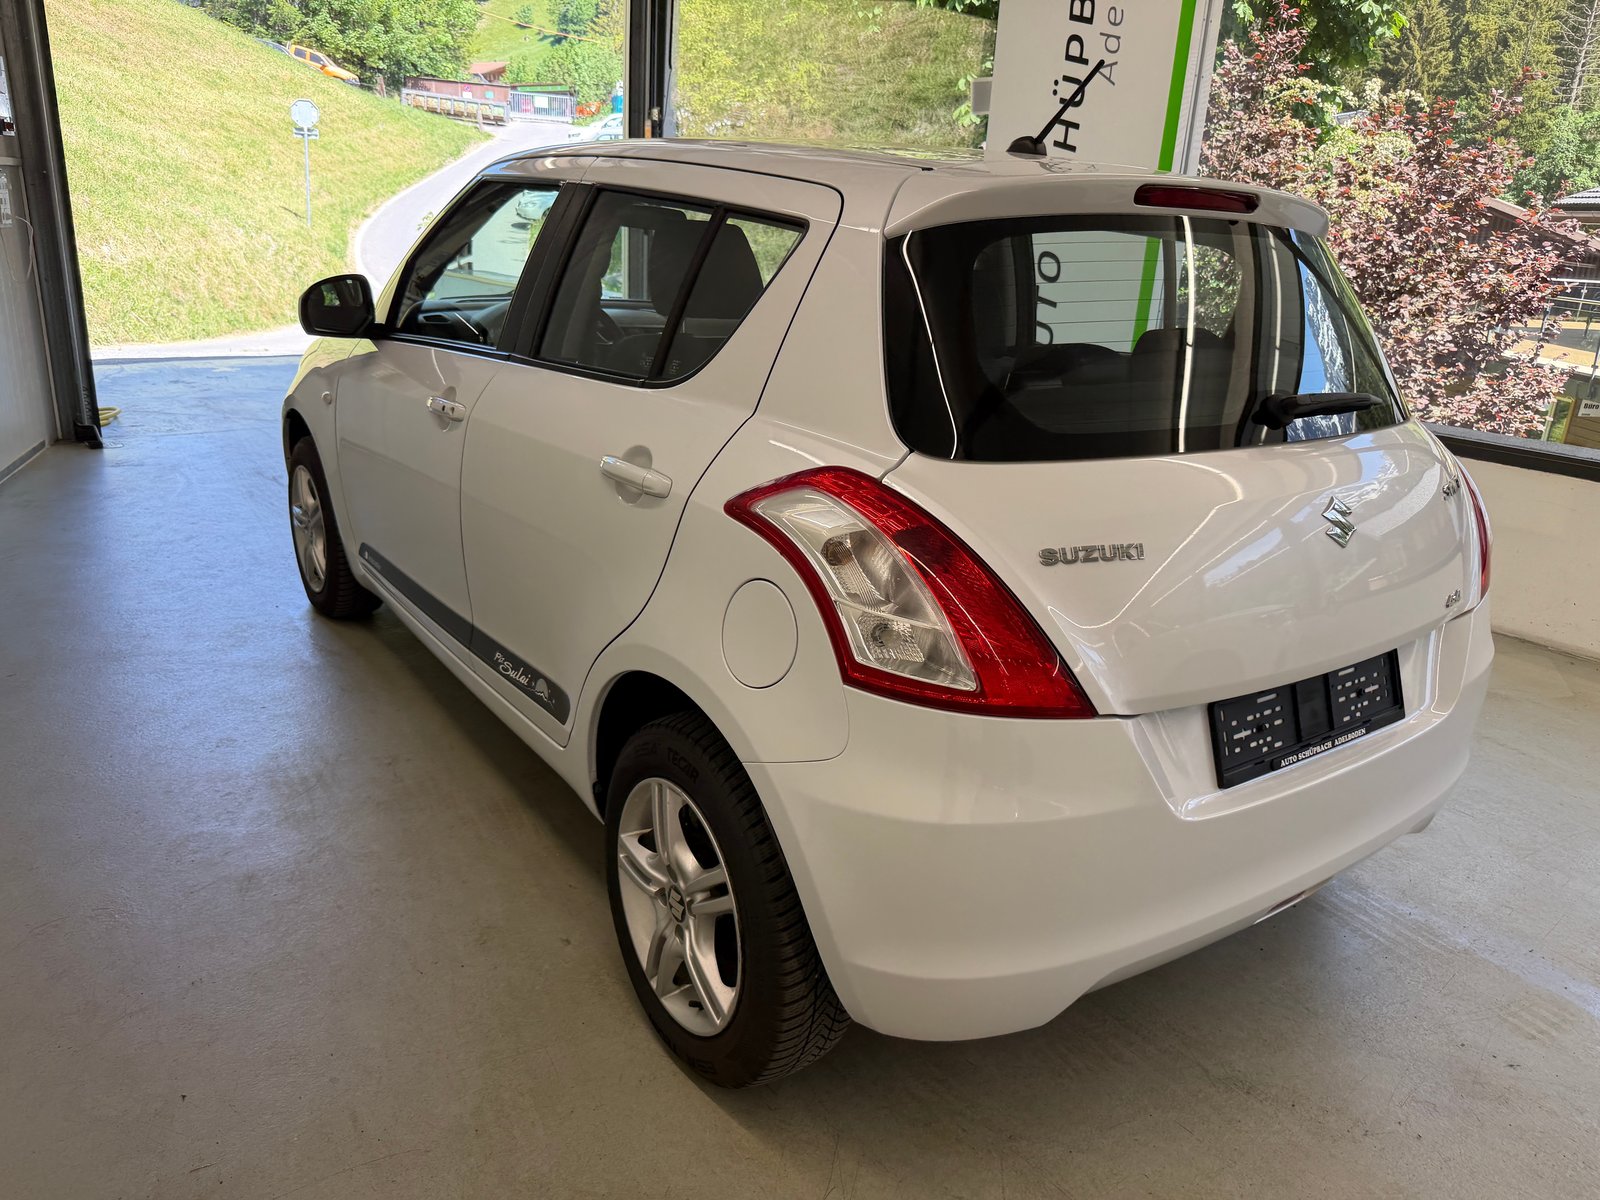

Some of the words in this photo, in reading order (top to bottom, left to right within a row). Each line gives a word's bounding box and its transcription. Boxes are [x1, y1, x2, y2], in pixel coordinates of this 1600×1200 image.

[1098, 5, 1124, 86] Ade
[1038, 542, 1145, 567] SUZUKI
[500, 661, 531, 686] Sulai
[1280, 755, 1298, 767] AUTO
[1298, 740, 1333, 760] SCHÜPBACH
[1334, 727, 1366, 746] ADELBODEN
